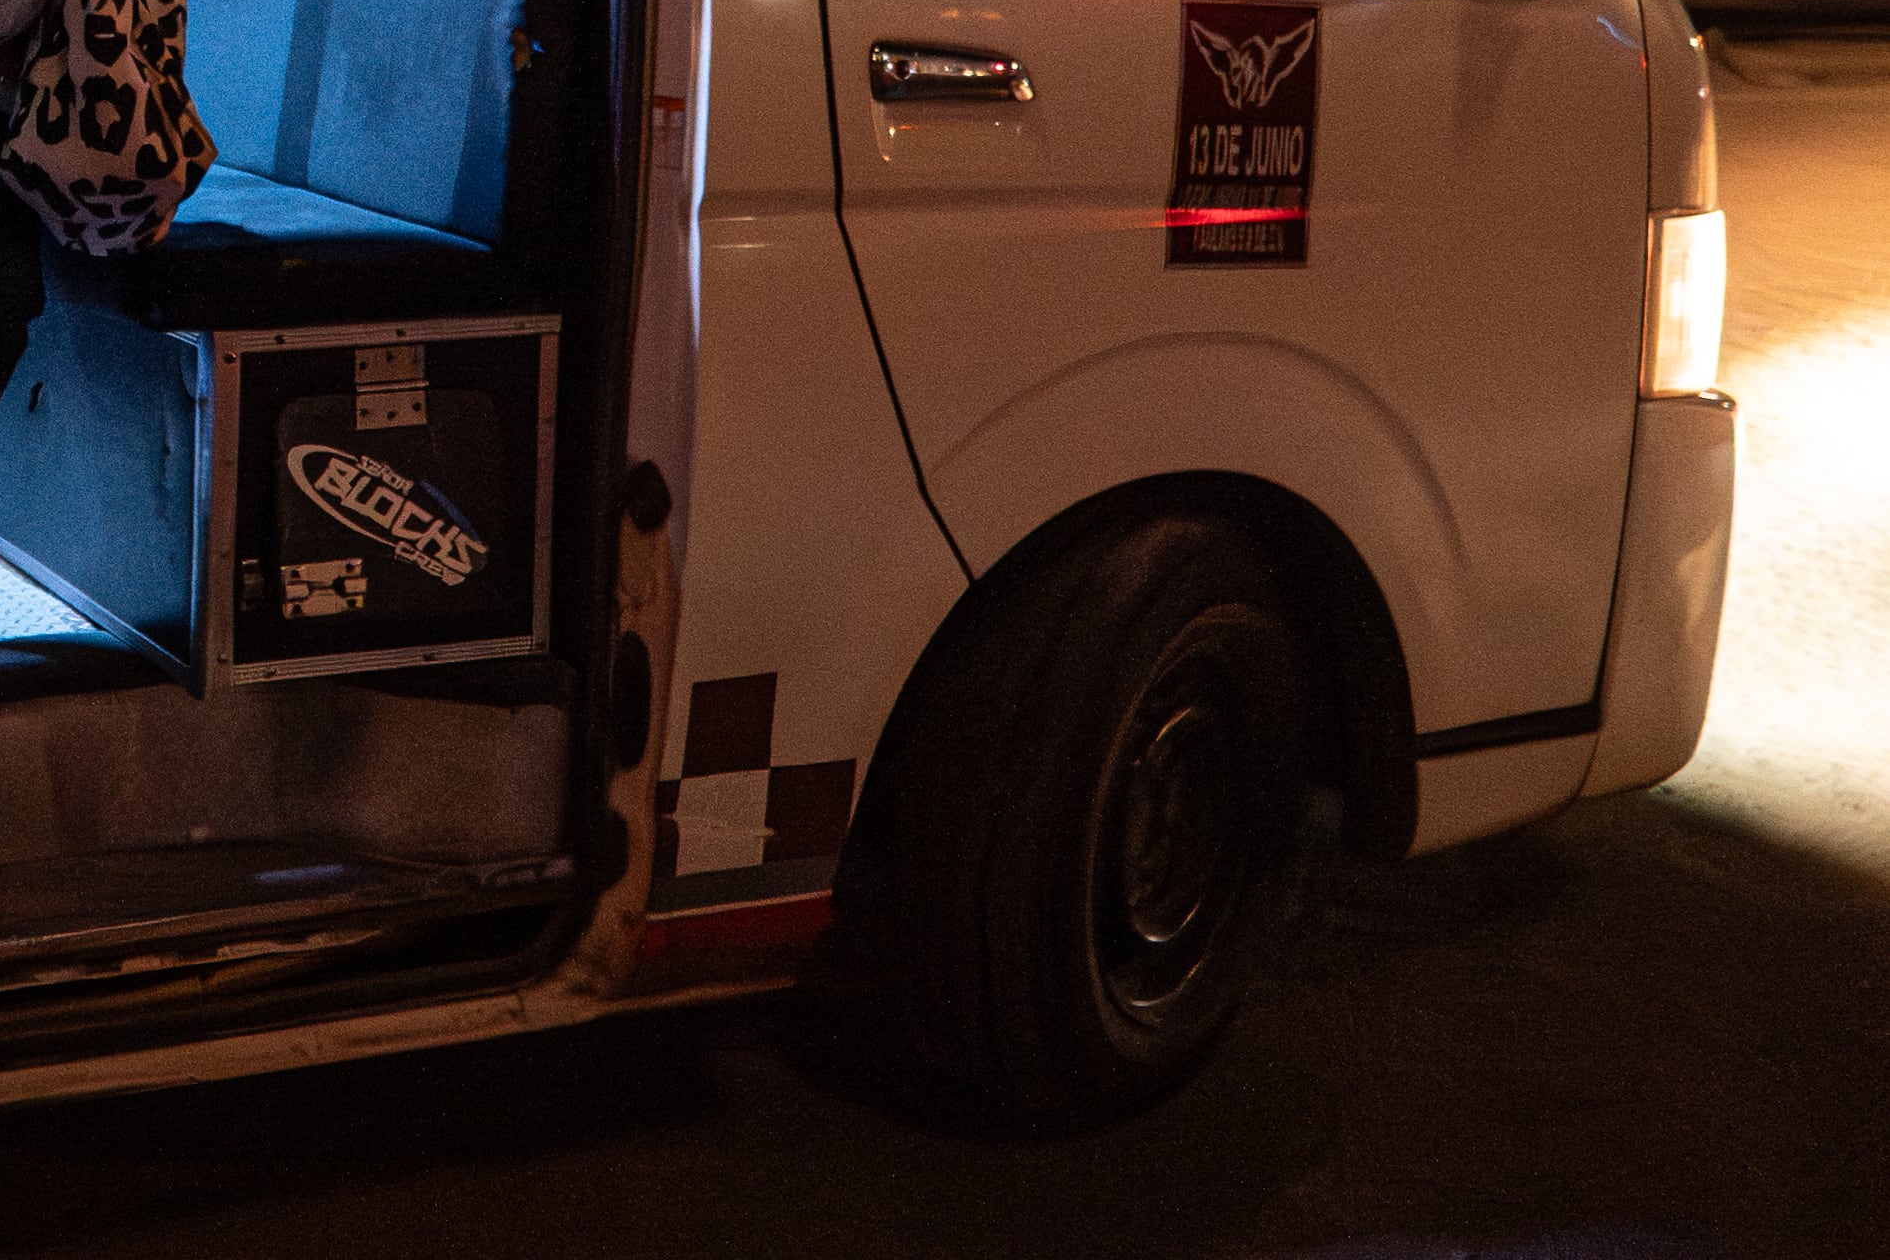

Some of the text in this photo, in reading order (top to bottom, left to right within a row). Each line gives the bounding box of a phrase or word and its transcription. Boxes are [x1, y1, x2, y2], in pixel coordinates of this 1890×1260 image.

[1189, 124, 1305, 176] 13 DE JUNIO
[314, 457, 490, 575] BLOCKS
